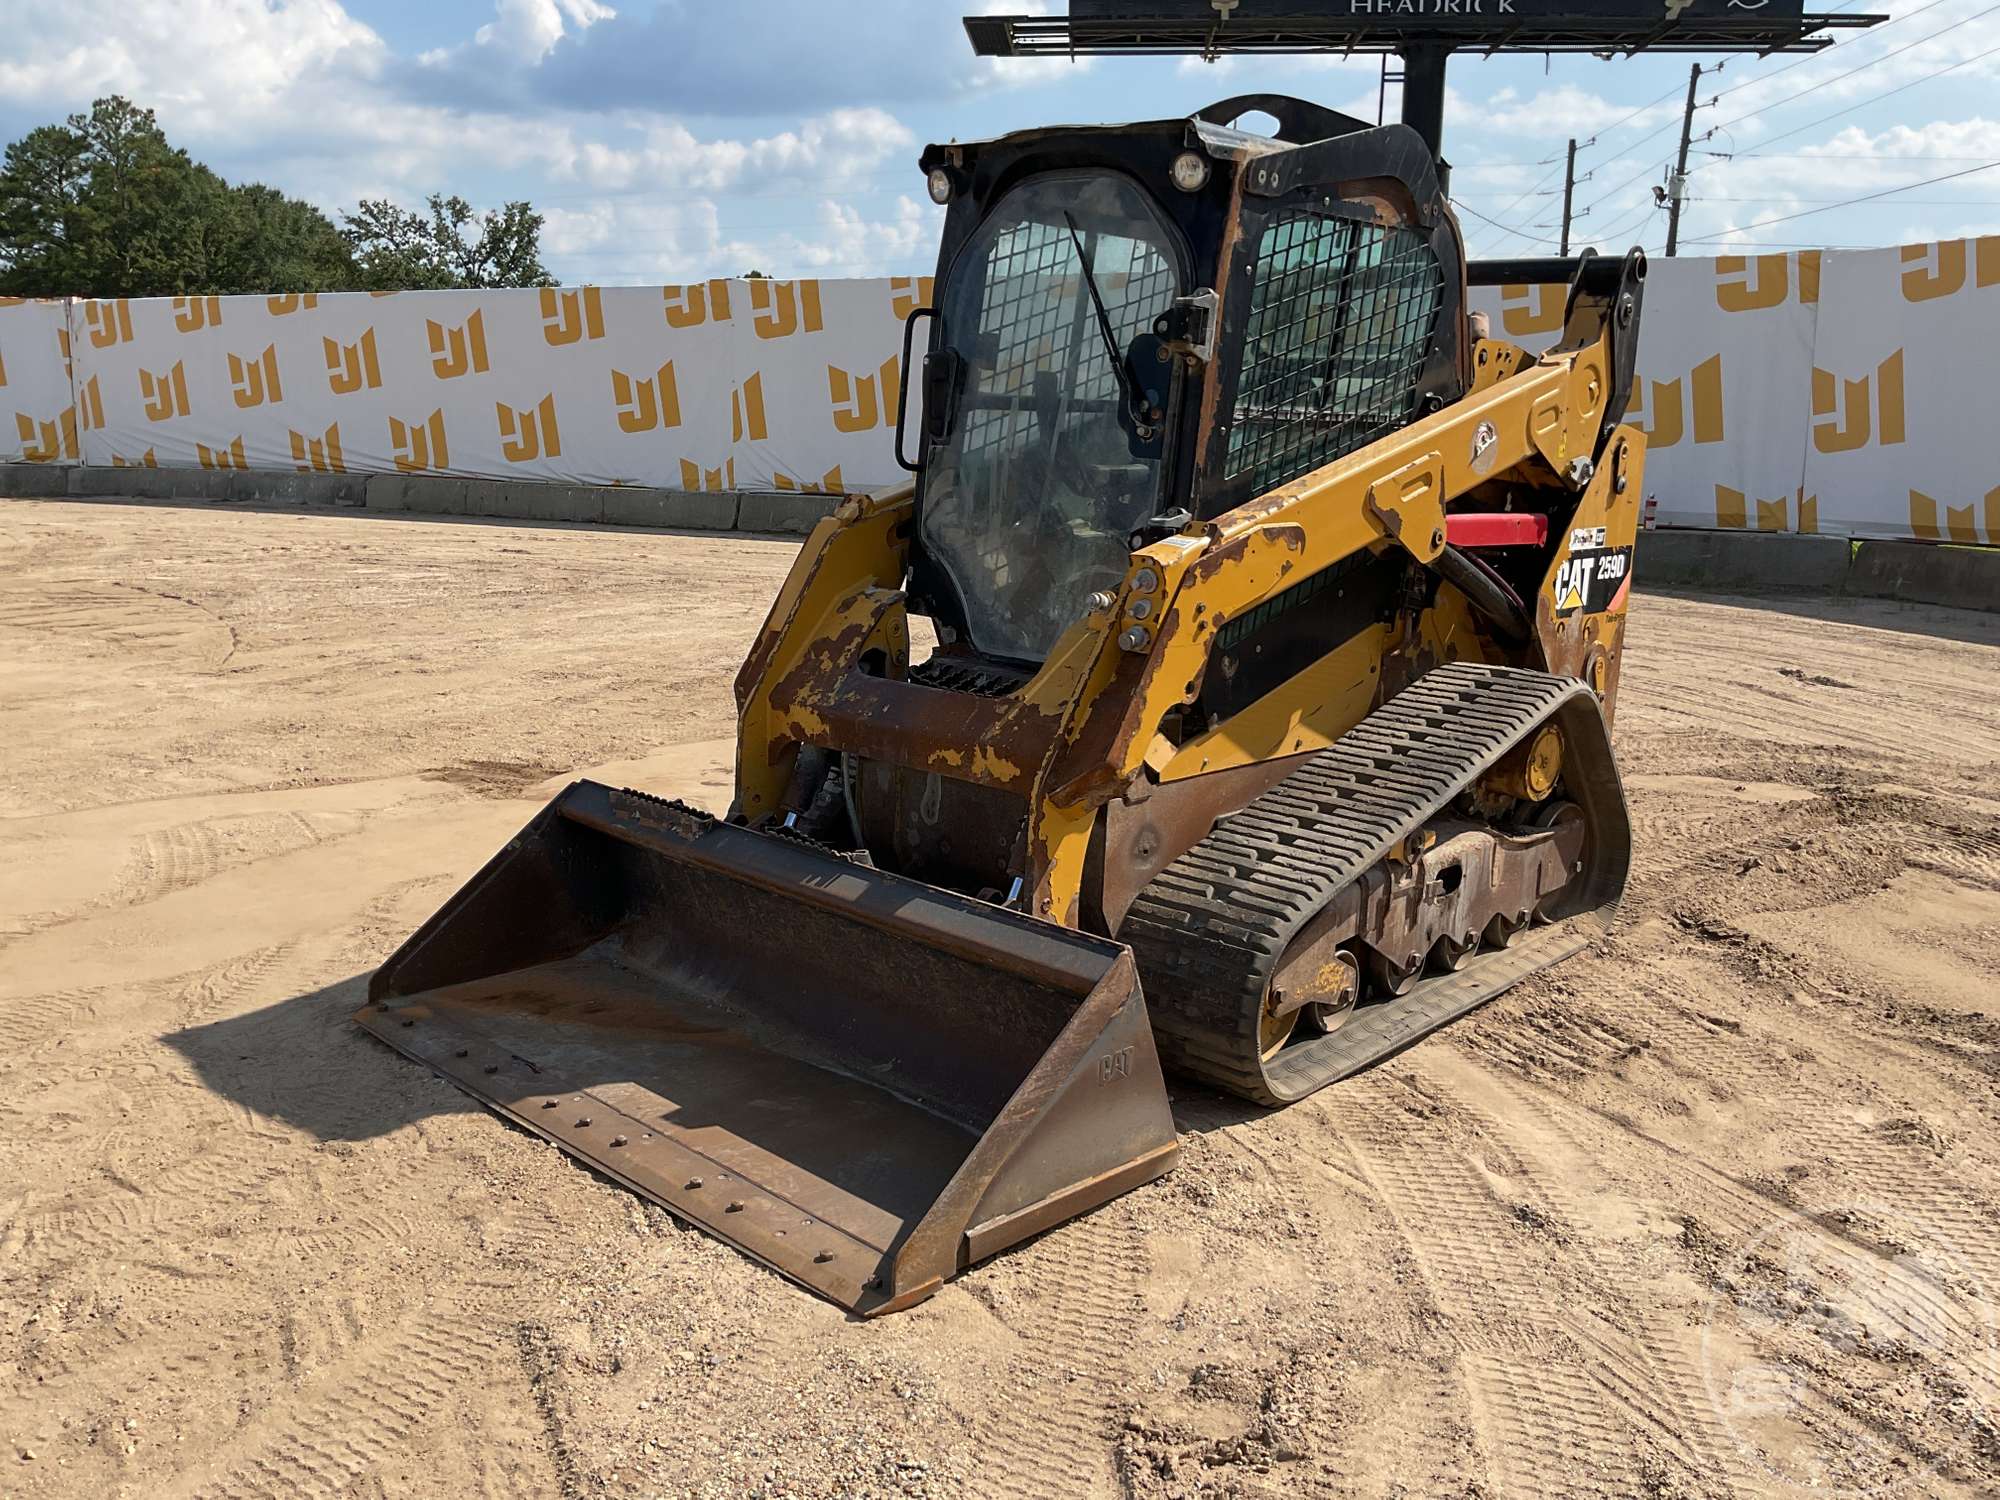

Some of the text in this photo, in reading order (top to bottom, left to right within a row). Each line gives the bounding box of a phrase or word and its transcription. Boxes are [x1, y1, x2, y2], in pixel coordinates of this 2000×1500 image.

[1555, 554, 1626, 609] CAT 259D
[1098, 1046, 1135, 1086] CAT
